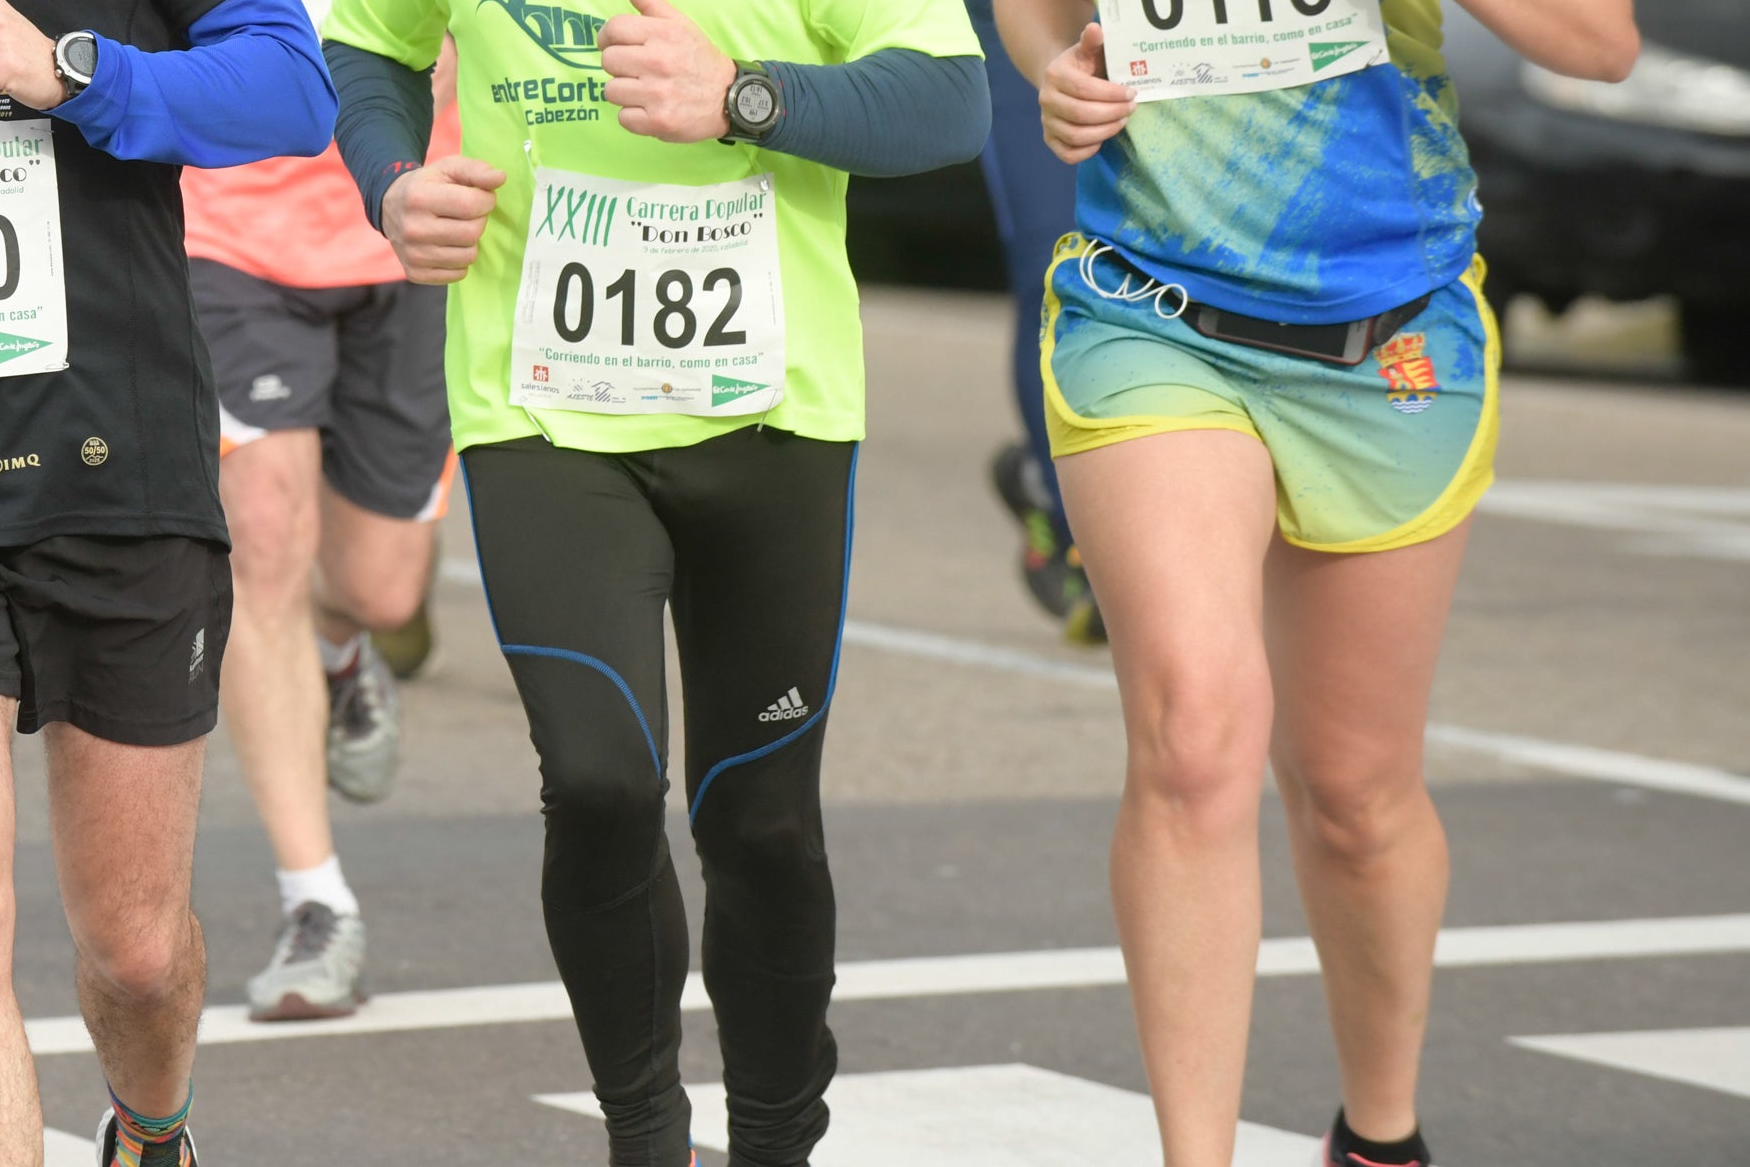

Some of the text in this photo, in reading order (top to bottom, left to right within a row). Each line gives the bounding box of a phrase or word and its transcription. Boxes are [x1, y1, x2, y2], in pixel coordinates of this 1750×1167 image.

[1200, 35, 1214, 47] en
[1217, 33, 1228, 46] el
[1231, 31, 1269, 45] barrio,
[1273, 28, 1305, 42] como
[1308, 24, 1322, 36] en
[525, 105, 599, 126] Cabezón
[535, 184, 618, 247] XXIII
[626, 192, 767, 221] Carrera Popular
[650, 246, 659, 254] de
[660, 246, 690, 254] febrero
[691, 245, 700, 254] de
[553, 262, 747, 349] 0182
[604, 355, 618, 367] en
[622, 354, 633, 367] el
[637, 355, 676, 370] barrio,
[680, 357, 711, 369] como
[715, 356, 728, 368] en
[521, 383, 560, 395] salesianos
[4, 453, 41, 471] IMQ
[758, 705, 809, 722] adidas
